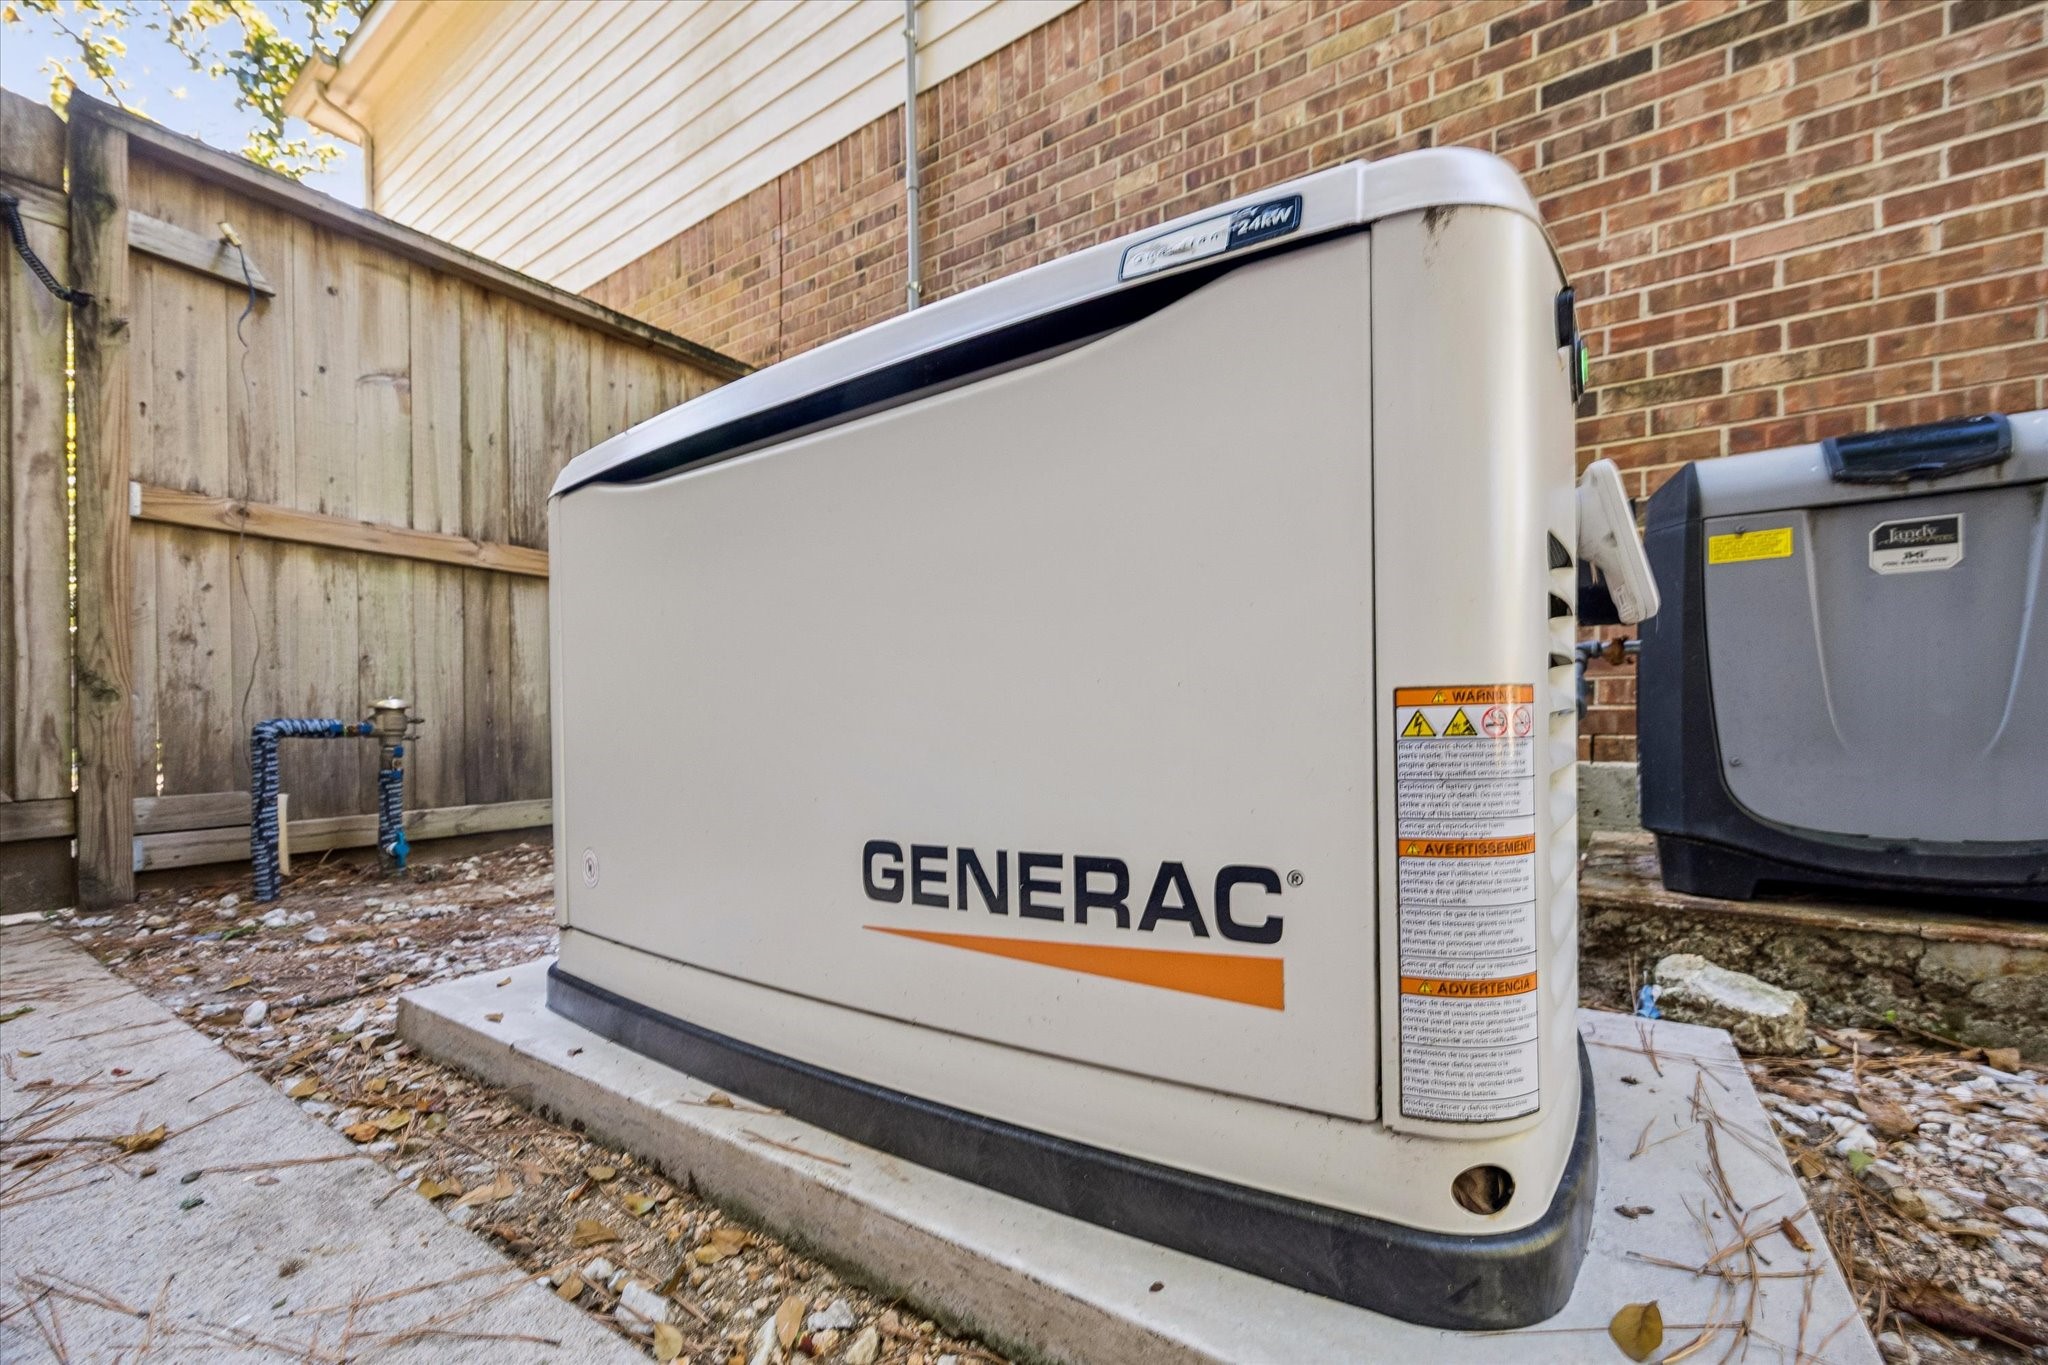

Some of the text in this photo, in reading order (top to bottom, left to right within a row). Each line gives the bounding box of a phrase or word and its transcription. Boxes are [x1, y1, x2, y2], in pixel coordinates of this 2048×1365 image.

[1237, 205, 1293, 237] 24kW
[1452, 690, 1518, 703] WARNIN
[1423, 838, 1532, 855] AVERTISSEMENT
[862, 840, 1284, 944] GENERAC
[1437, 979, 1530, 994] ADVERTENCIA
